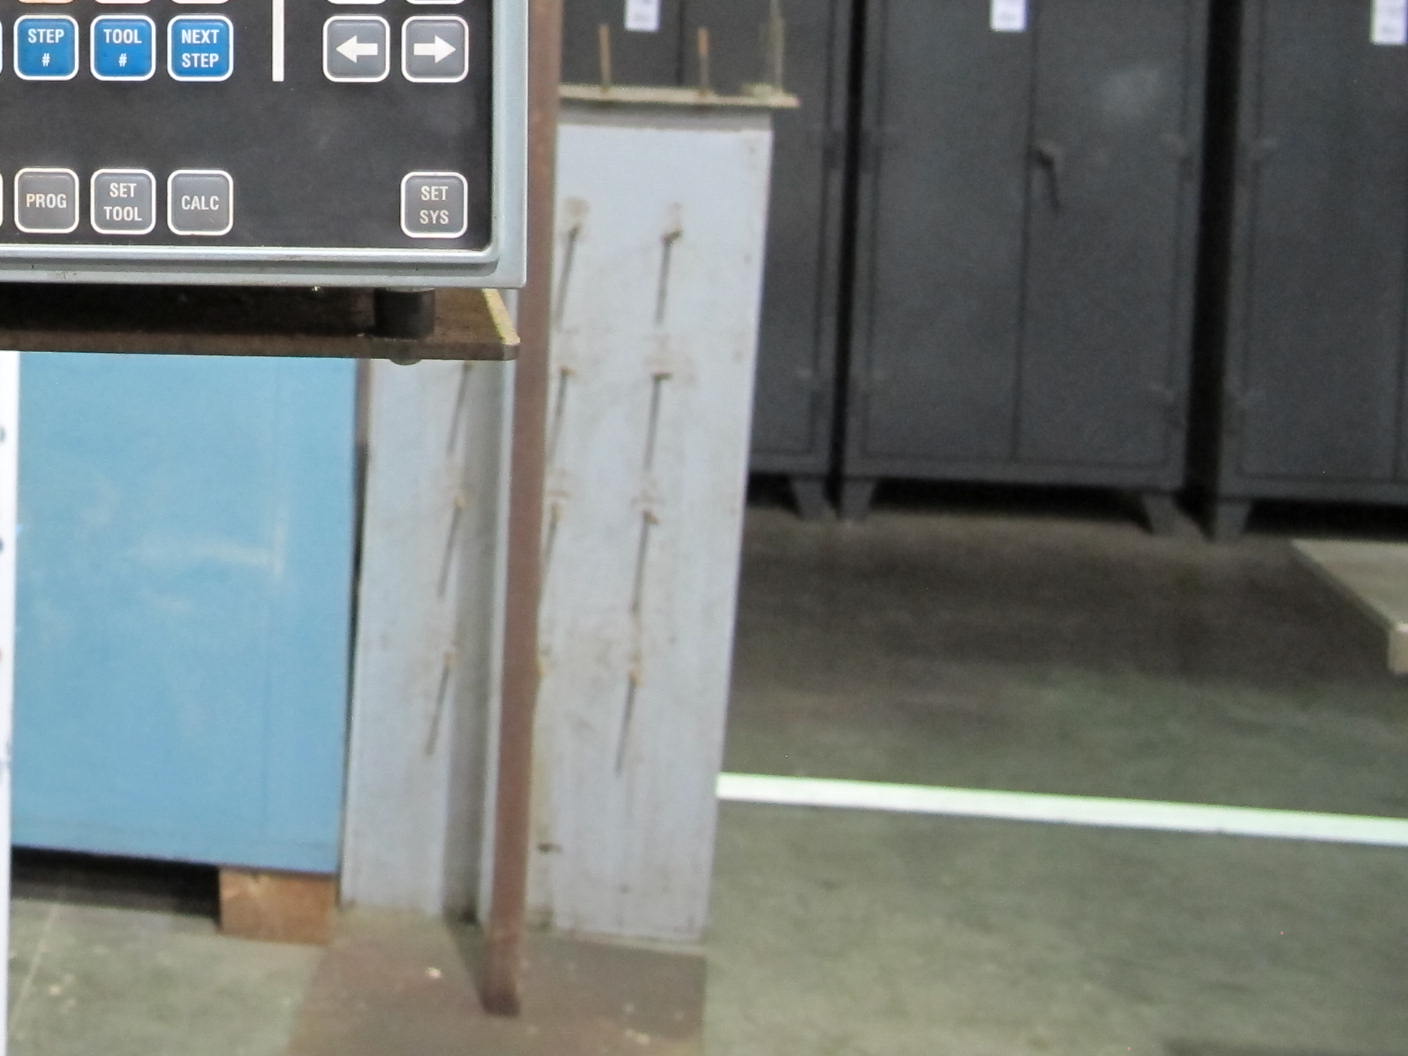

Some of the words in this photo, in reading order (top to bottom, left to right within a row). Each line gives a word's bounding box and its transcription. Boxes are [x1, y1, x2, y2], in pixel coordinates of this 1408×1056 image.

[28, 29, 64, 43] STEP
[104, 29, 142, 44] TOOL
[182, 29, 219, 43] NEXT
[42, 53, 50, 66] #
[119, 53, 127, 66] #
[182, 53, 219, 67] STEP
[110, 183, 136, 197] SET
[421, 186, 448, 200] SET
[27, 194, 66, 208] PROG
[182, 196, 219, 210] CALC
[104, 206, 142, 221] TOOL
[420, 210, 448, 224] SYS
